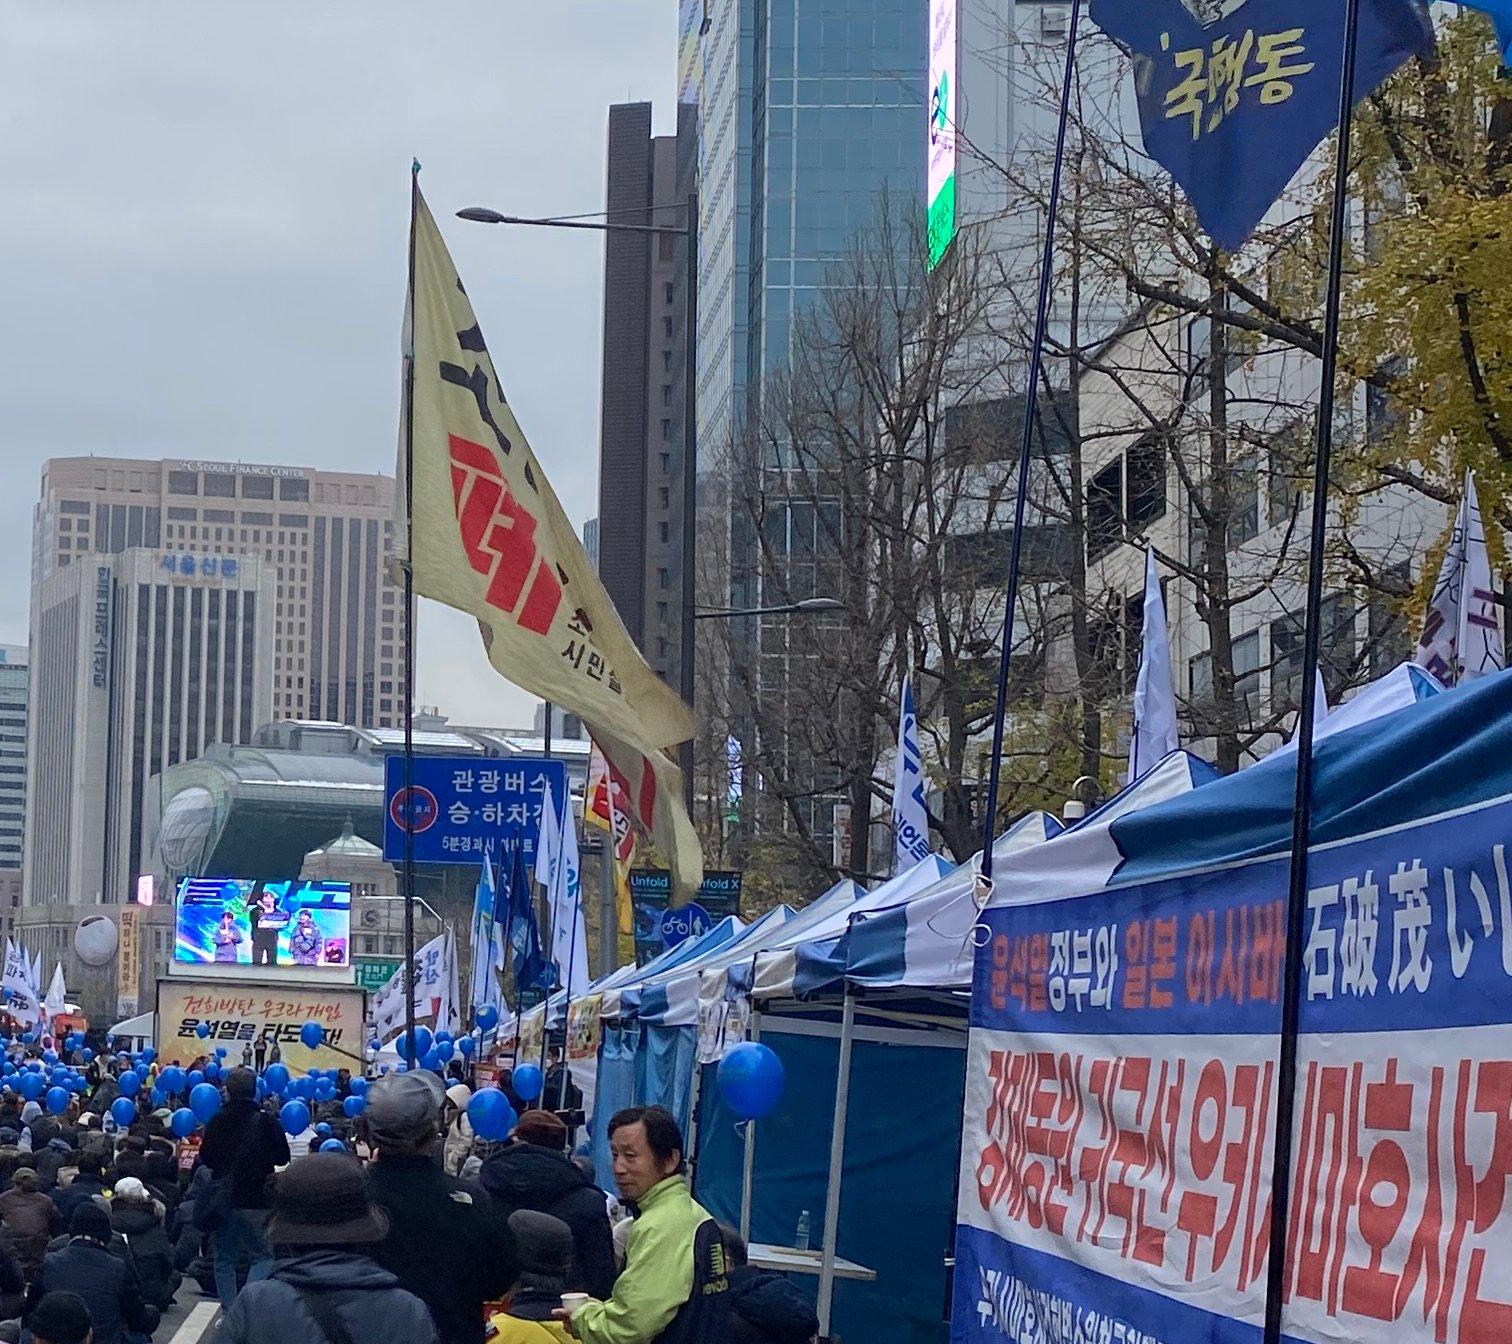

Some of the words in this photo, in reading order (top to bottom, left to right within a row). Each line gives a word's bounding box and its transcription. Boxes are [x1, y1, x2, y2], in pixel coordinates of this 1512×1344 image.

[159, 554, 238, 578] 서울신문
[451, 769, 552, 794] 관광버스
[630, 877, 668, 888] Unfold
[697, 878, 729, 889] nfold
[1122, 915, 1178, 1009] 일본
[1185, 899, 1287, 1006] 이시바
[182, 994, 255, 1018] 건희방탄
[260, 999, 304, 1019] 우크라
[306, 1002, 345, 1023] 개입
[261, 1023, 343, 1046] 타도자!
